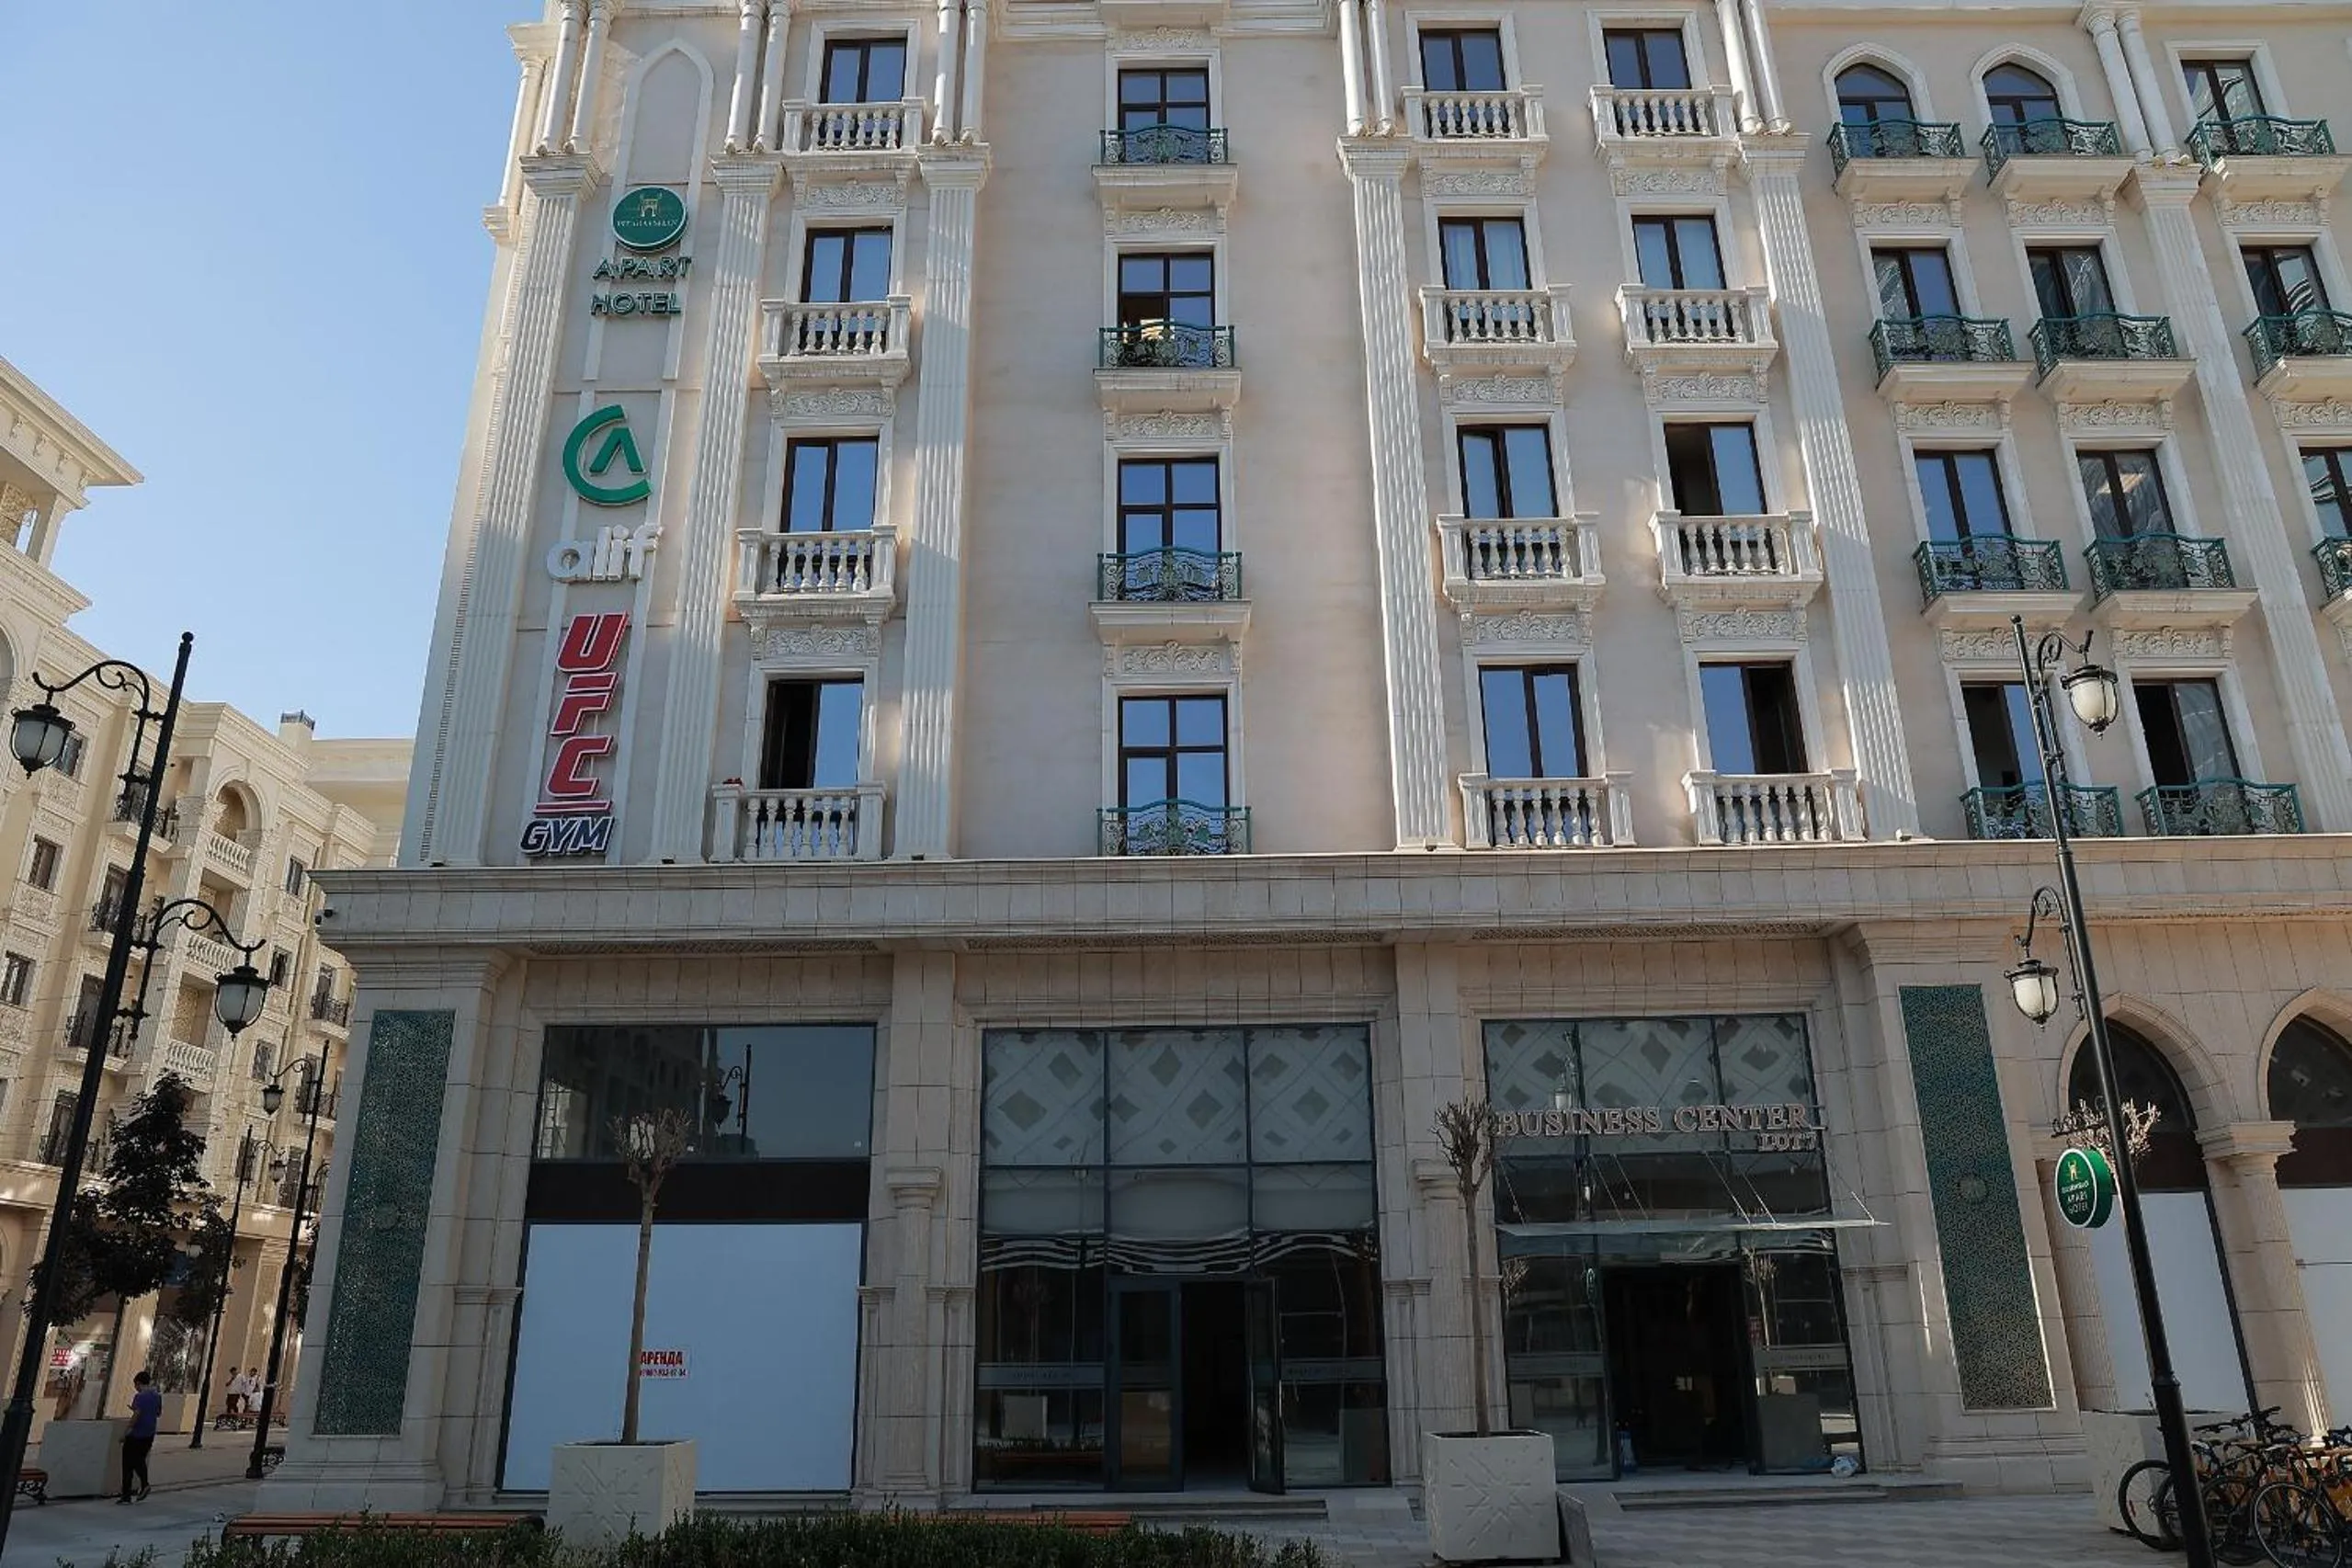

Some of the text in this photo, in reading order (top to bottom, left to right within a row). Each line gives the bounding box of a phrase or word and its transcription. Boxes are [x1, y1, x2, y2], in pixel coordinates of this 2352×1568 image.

[593, 256, 692, 278] APART
[590, 291, 682, 315] HOTEL
[547, 524, 664, 581] alif
[546, 611, 629, 799] UFC
[519, 816, 615, 856] GYM
[1495, 1103, 1814, 1136] BUSINESS CENTER
[641, 1351, 683, 1366] АРЕНДА
